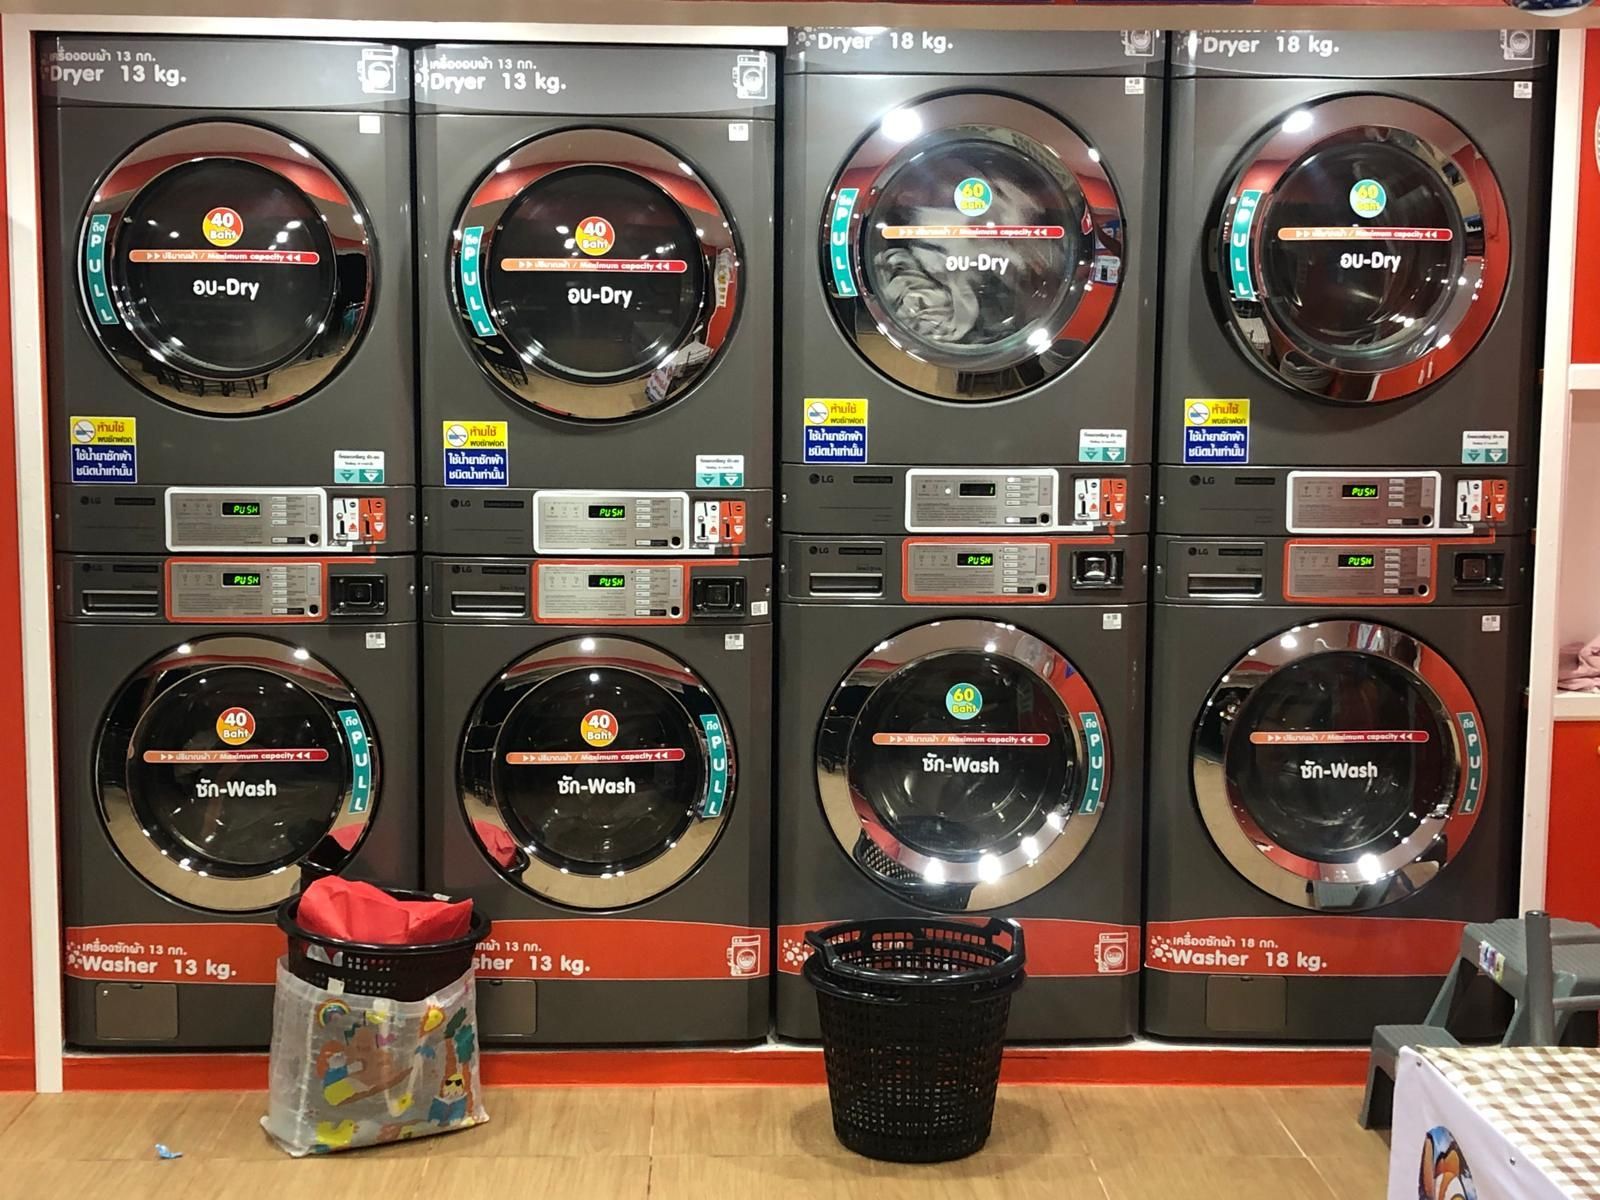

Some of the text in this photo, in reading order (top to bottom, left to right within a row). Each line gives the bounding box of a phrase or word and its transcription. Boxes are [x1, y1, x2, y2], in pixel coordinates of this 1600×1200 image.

[818, 31, 954, 54] Dryer 18 kg.
[1204, 34, 1340, 58] Dryer 18 kg.
[116, 51, 132, 62] 13
[136, 52, 156, 62] กก.
[498, 59, 512, 70] 13
[517, 60, 537, 70] กก.
[50, 64, 187, 86] Dryer 13 kg.
[430, 72, 566, 94] Dryer 13 kg.
[962, 183, 984, 198] 60
[1356, 184, 1379, 200] 60
[210, 212, 234, 228] 40
[210, 230, 238, 240] Baht
[583, 222, 607, 236] 40
[1000, 229, 1032, 238] capacity
[1394, 231, 1424, 240] capacity
[832, 207, 852, 294] PULL
[250, 254, 284, 263] capacity
[946, 253, 1010, 276] อบ-Dry
[1340, 251, 1402, 273] อบ-Dry
[620, 262, 654, 272] capacity
[90, 234, 112, 322] PULL
[192, 278, 260, 300] อบ-Dry
[464, 246, 490, 334] PULL
[567, 286, 632, 308] อบ-Dry
[830, 402, 856, 414] ห้ามใช้
[1212, 402, 1239, 414] ห้ามใช้
[96, 421, 124, 433] ห้ามใช้
[470, 425, 497, 436] ห้ามใช้
[808, 428, 863, 442] ใช้น้ำยาซักผ้า
[1188, 428, 1244, 442] ใช้น้ำยาซักผ้า
[75, 447, 132, 461] ใช้น้ำยาซักผ้า
[808, 443, 864, 457] ชนิดน้ำเท่านั้น
[1188, 443, 1245, 457] ชนิดน้ำเท่านั้น
[448, 452, 504, 465] ใช้น้ำยาซักผ้า
[76, 463, 133, 476] ชนิดน้ำเท่านั้น
[448, 466, 504, 480] ชนิดน้ำเท่านั้น
[821, 474, 834, 484] LG
[1202, 476, 1215, 485] LG
[1352, 487, 1376, 496] PUSH
[233, 504, 258, 514] PUSH
[600, 508, 623, 517] PUSH
[968, 556, 992, 565] PUSH
[1348, 556, 1372, 566] PUSH
[234, 576, 260, 585] PUSH
[600, 577, 623, 586] PUSH
[953, 688, 974, 702] 60
[952, 704, 976, 714] Baht
[224, 712, 247, 727] 40
[588, 715, 610, 729] 40
[223, 729, 248, 738] Baht
[587, 730, 612, 740] Baht
[987, 736, 1018, 744] capacity
[1366, 733, 1398, 742] capacity
[260, 753, 295, 762] capacity
[620, 753, 653, 761] capacity
[922, 752, 1000, 774] ซัก-Wash
[352, 731, 368, 810] PULL
[708, 736, 724, 814] PULL
[1085, 734, 1102, 812] PULL
[1300, 760, 1378, 780] ซัก-Wash
[1464, 734, 1480, 812] PULL
[196, 778, 277, 798] ซัก-Wash
[557, 775, 636, 795] ซัก-Wash
[82, 938, 188, 956] เครื่องซักผ้า 13 กก.
[505, 942, 519, 952] 13
[523, 942, 542, 952] กก.
[1172, 932, 1278, 948] เครื่องซักผ้า 18 กก.
[82, 956, 237, 980] Washer 13 kg.
[472, 954, 591, 976] sher 13 kg.
[1172, 950, 1328, 972] Washer 18 kg.
